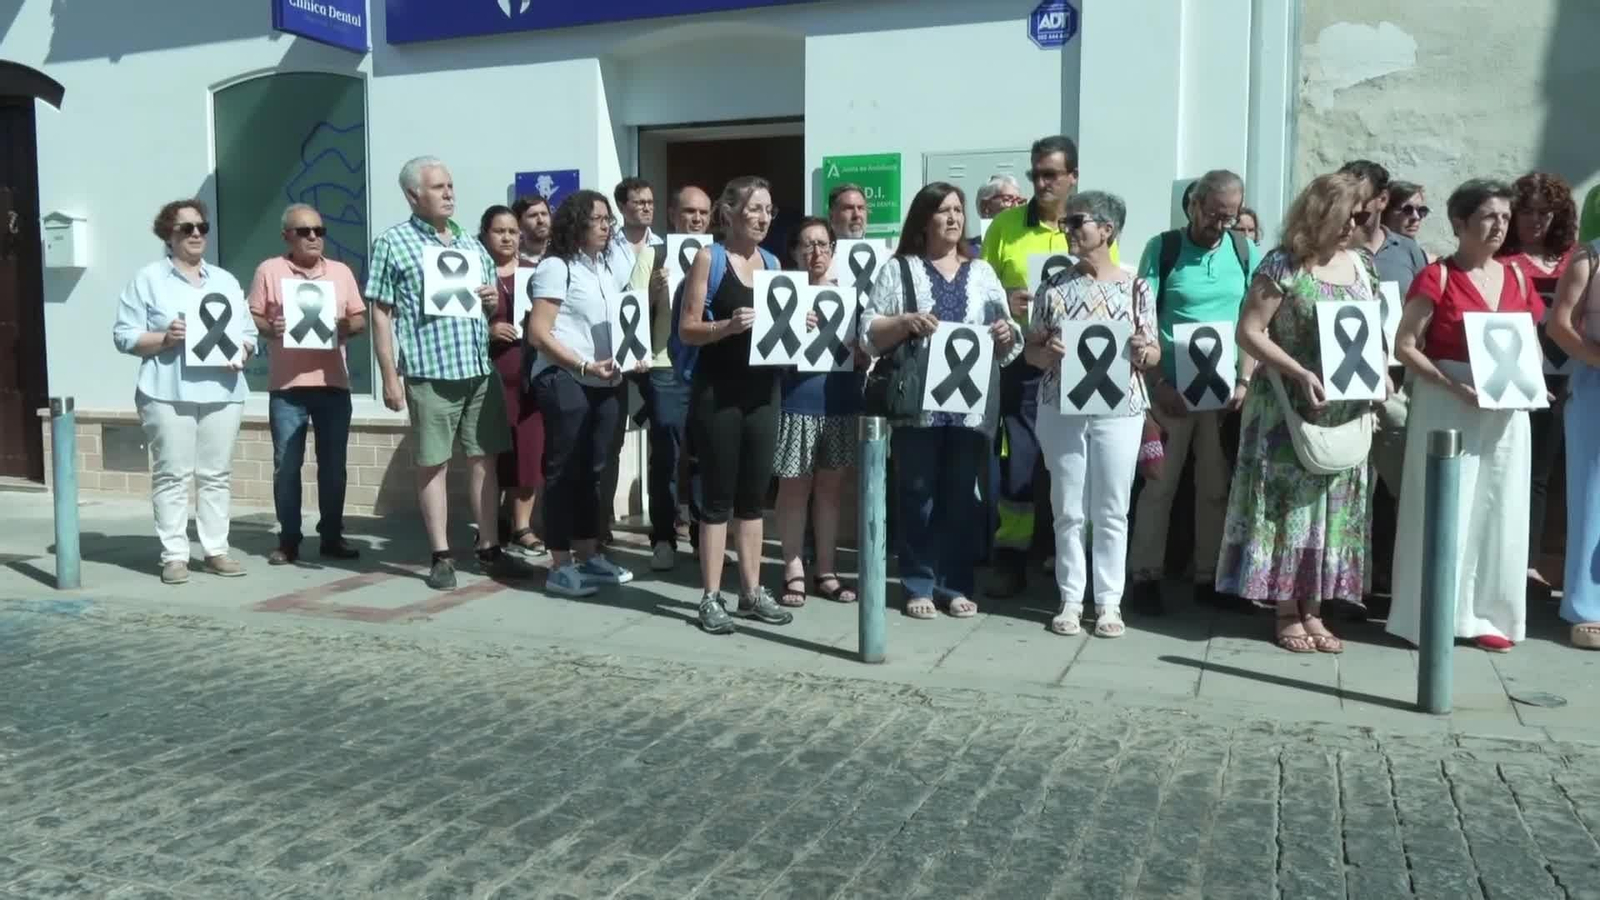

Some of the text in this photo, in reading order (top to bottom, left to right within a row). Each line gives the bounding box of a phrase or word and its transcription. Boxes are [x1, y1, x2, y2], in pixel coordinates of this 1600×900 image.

[328, 5, 361, 27] Dental
[1039, 12, 1066, 29] ADT
[864, 186, 885, 199] D.I.
